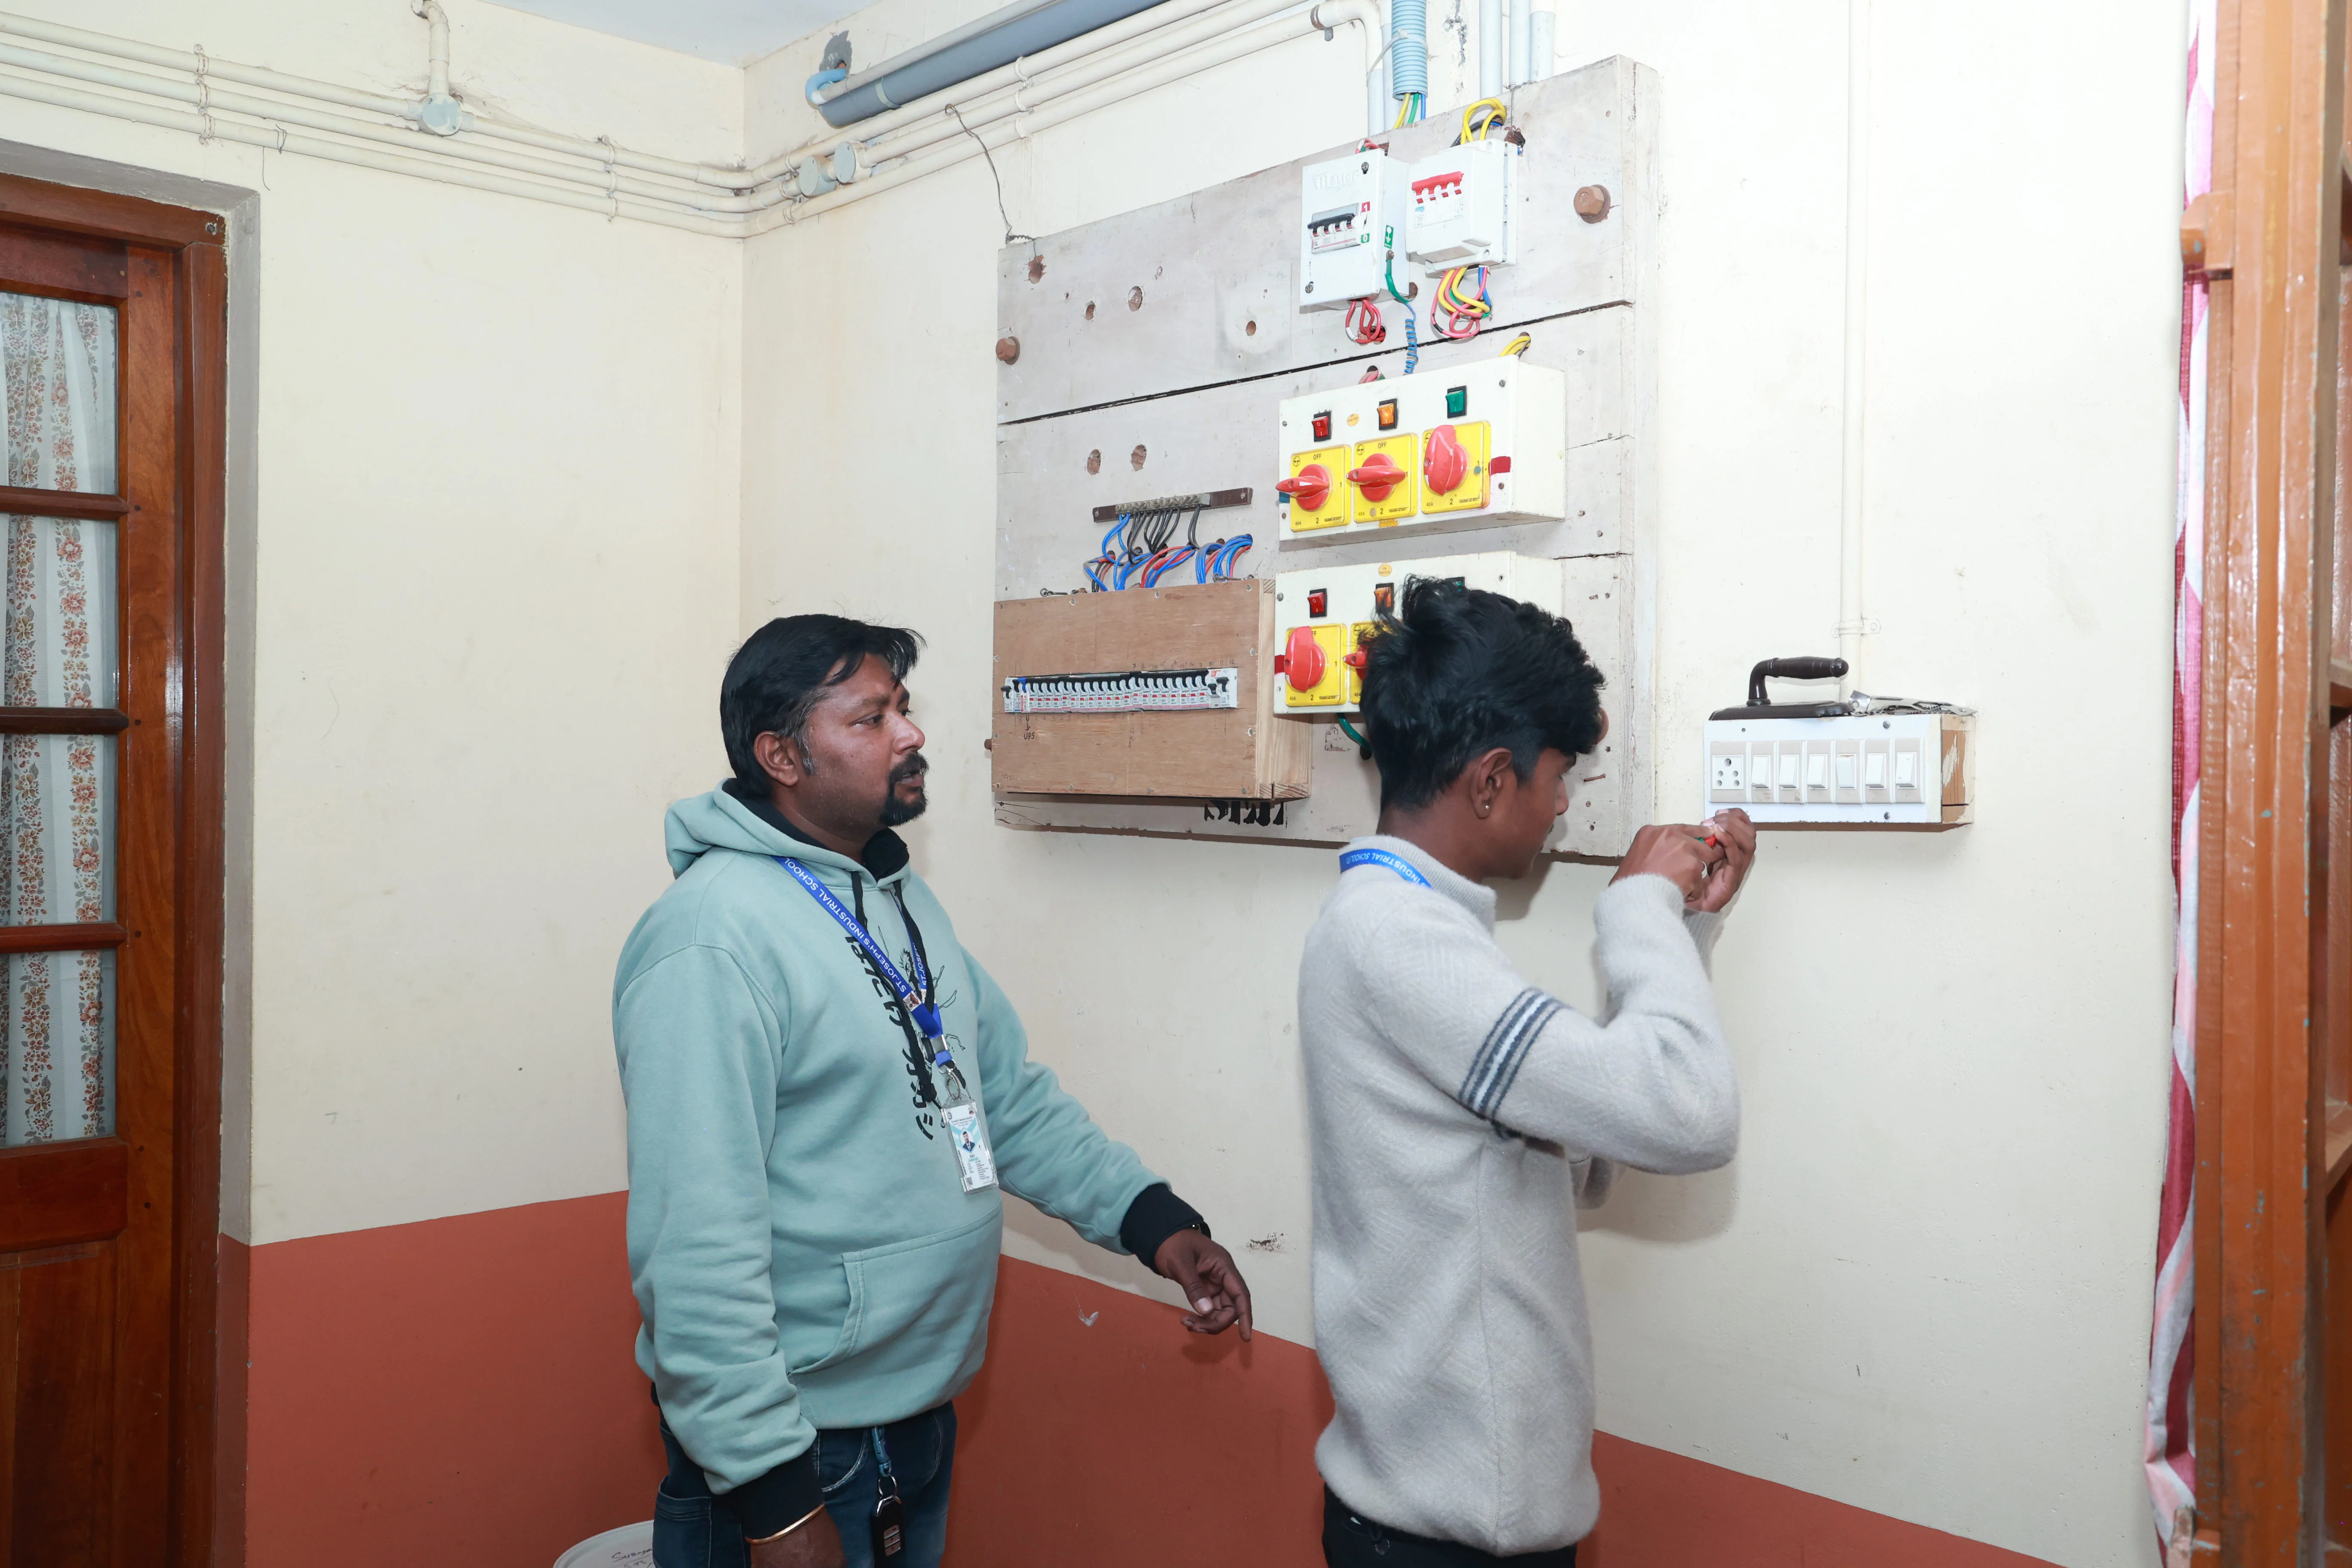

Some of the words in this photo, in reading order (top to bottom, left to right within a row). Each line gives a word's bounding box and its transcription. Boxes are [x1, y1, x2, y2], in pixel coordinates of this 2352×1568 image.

[1023, 732, 1035, 740] UPS
[784, 858, 818, 891] SCHOOL
[1372, 853, 1421, 883] INDUSTRIAL
[819, 888, 864, 939] INDUSTRIAL
[863, 938, 906, 992] ST.JOSEPH'S
